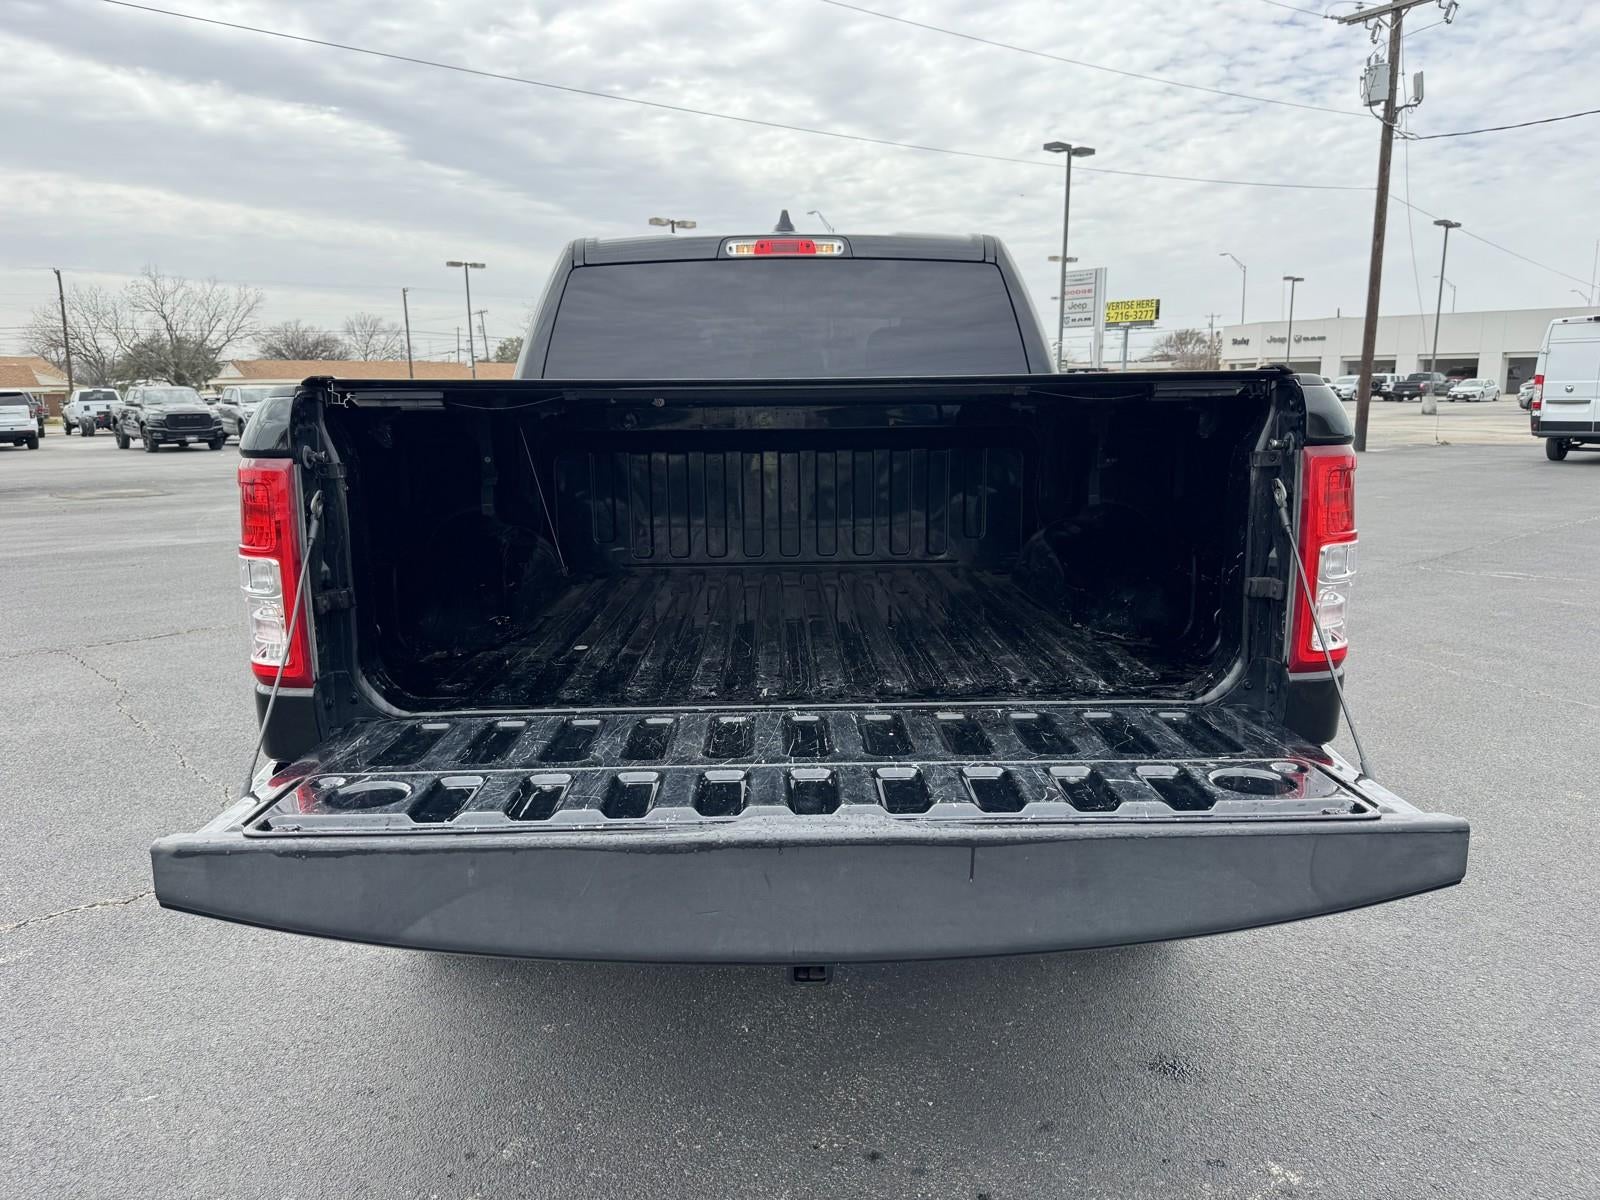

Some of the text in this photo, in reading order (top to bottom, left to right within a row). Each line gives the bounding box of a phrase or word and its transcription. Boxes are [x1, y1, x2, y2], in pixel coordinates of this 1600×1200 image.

[1067, 302, 1088, 312] Jeep
[1105, 299, 1155, 311] VERTISE HERE
[1105, 309, 1154, 321] 5-716-3277
